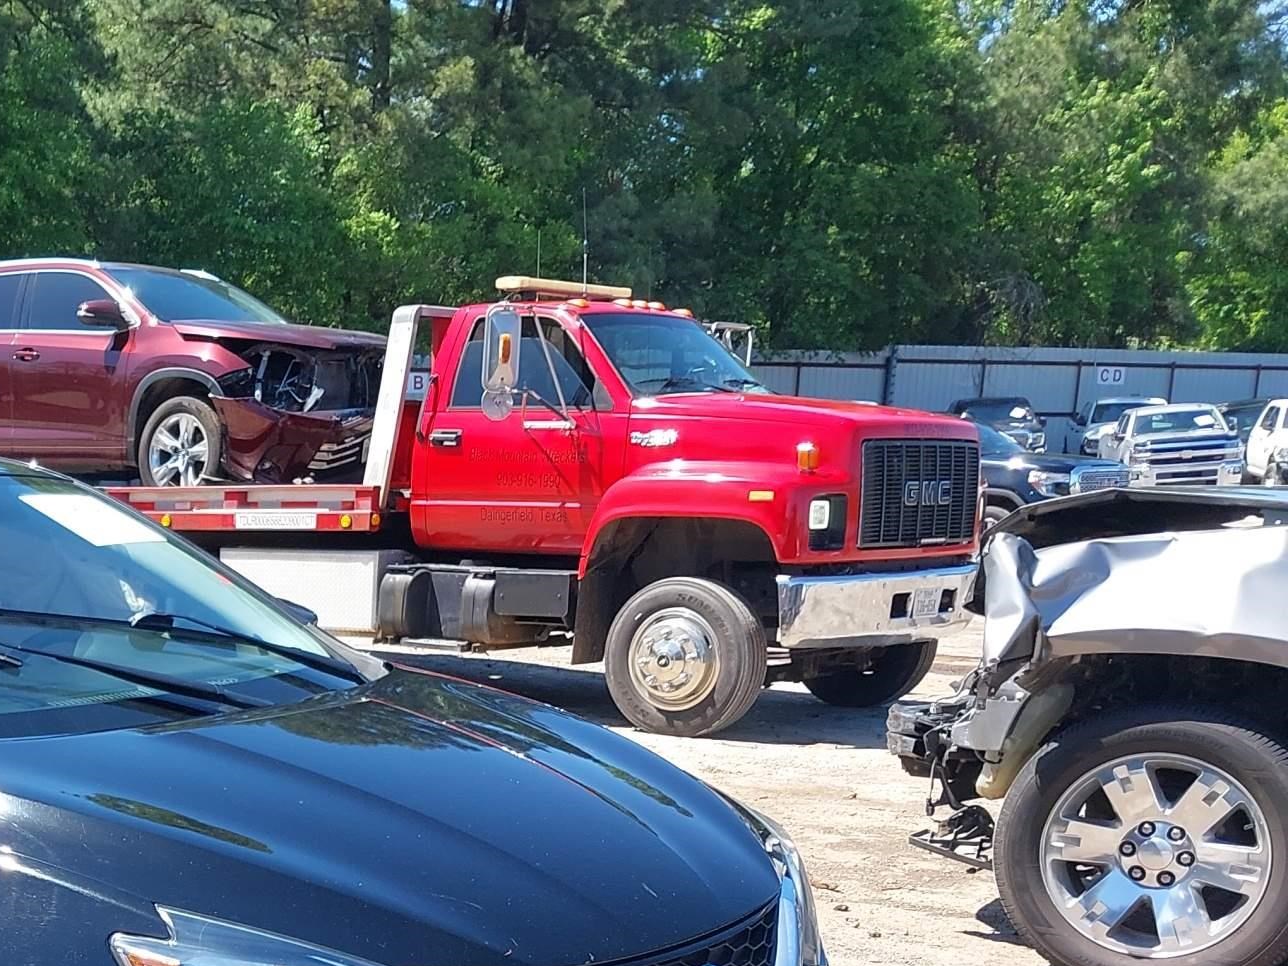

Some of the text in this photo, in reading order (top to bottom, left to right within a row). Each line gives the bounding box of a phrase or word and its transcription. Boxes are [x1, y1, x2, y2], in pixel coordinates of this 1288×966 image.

[413, 375, 424, 390] B
[904, 480, 952, 506] GMC
[540, 507, 569, 522] Texas
